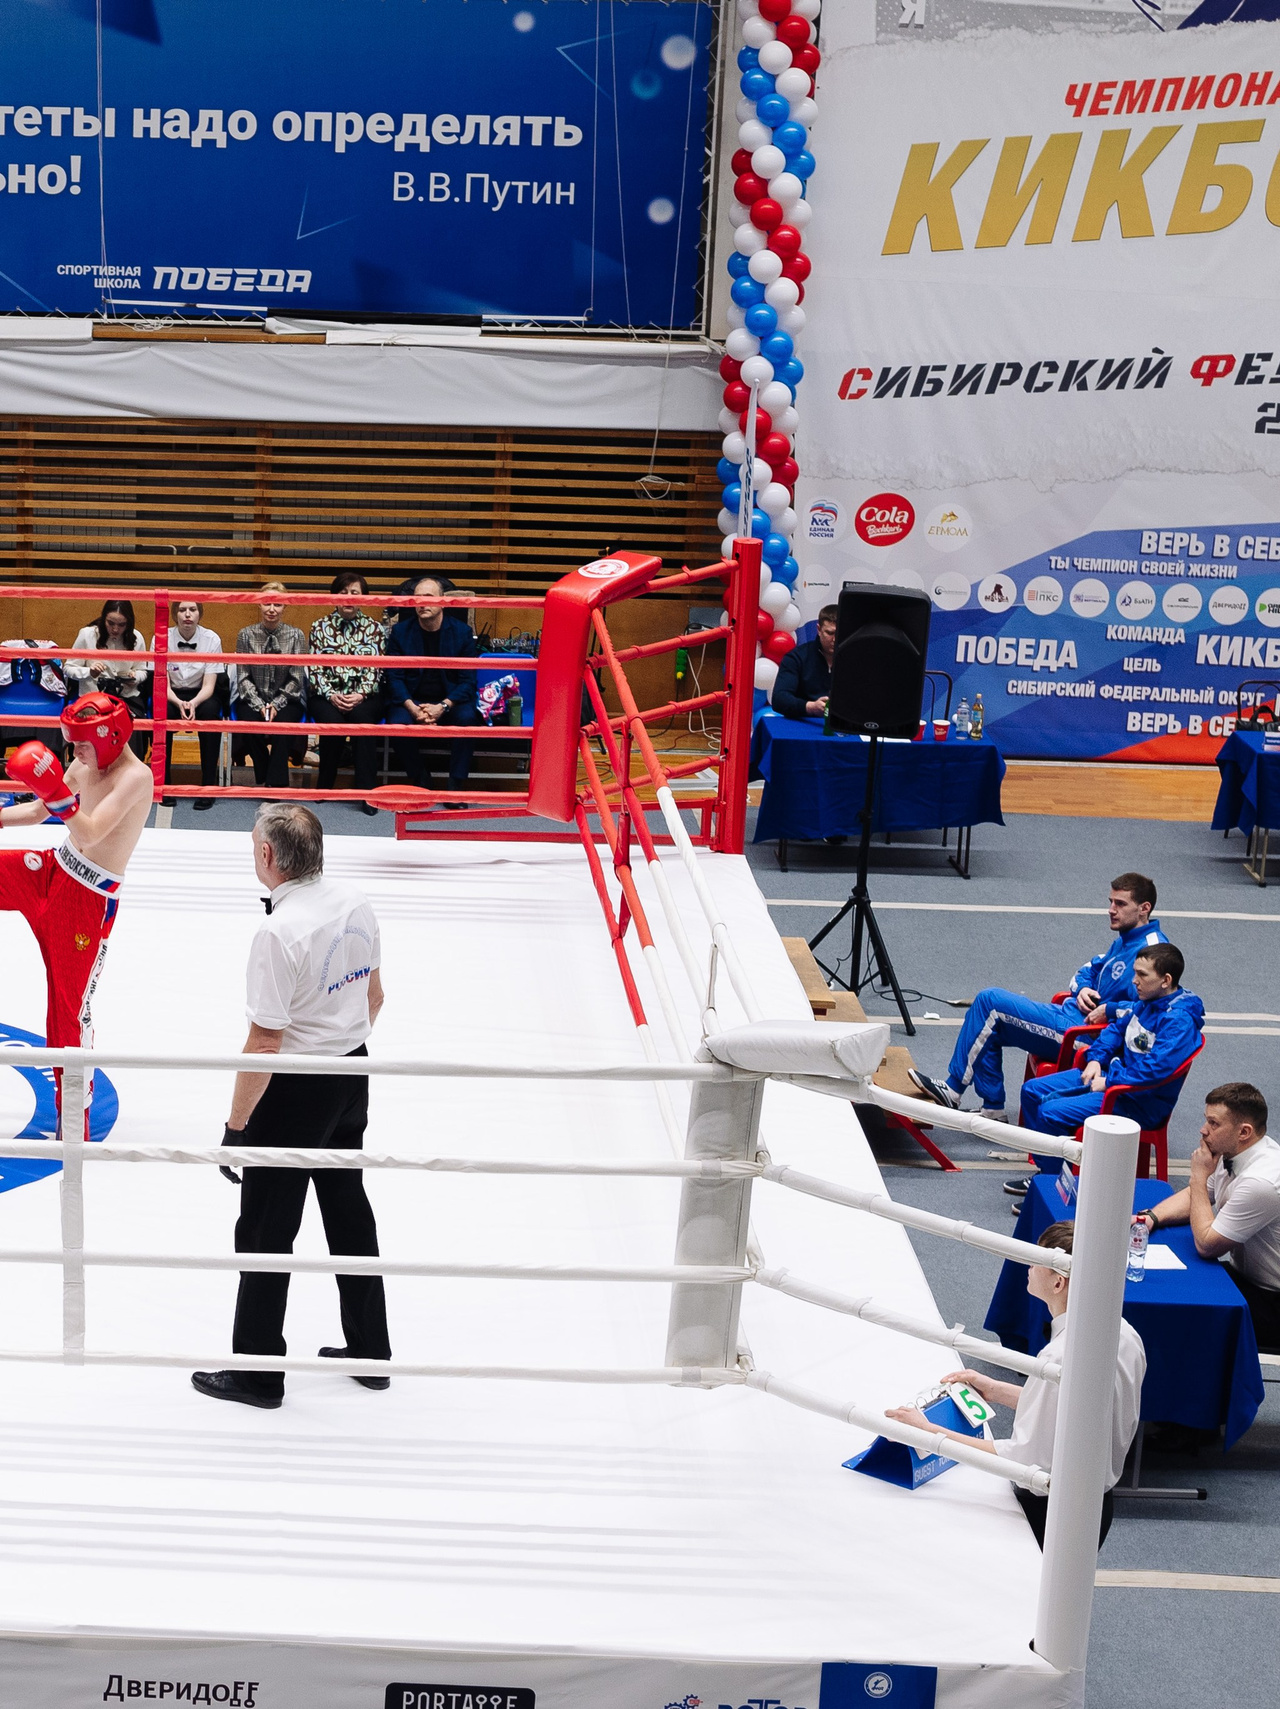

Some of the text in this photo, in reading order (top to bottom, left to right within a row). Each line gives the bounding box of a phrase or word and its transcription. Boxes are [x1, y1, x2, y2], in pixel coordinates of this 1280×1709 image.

[132, 107, 258, 149] надо
[272, 111, 584, 153] определять
[392, 171, 576, 212] В.В.Путин
[881, 119, 1280, 256] КИКБ
[57, 264, 141, 277] СПОРТИВНАЯ
[94, 278, 141, 289] ШКОЛА
[153, 266, 313, 293] ПОБЕДА
[837, 346, 1174, 401] СИБИРСКИЙ
[860, 506, 909, 524] Cola
[1141, 531, 1205, 556] ВЕРЬ
[1213, 534, 1230, 558] В
[1049, 556, 1238, 579] ТЫ ЧЕМПИОН СВОЕЙ ЖИЗНИ
[1039, 594, 1059, 602] ПКС
[1106, 624, 1186, 645] КОМАНДА
[955, 635, 1078, 672] ПОБЕДА
[1123, 657, 1162, 673] ЦЕЛЬ
[1007, 680, 1096, 699] СИБИРСКИЙ
[1099, 684, 1214, 705] ФЕДЕРАЛЬНЫЙ
[1218, 690, 1266, 707] ОКРУГ
[1127, 711, 1265, 737] ВЕРЬ В СЕ
[959, 1388, 987, 1421] 5
[914, 1460, 936, 1483] GUEST
